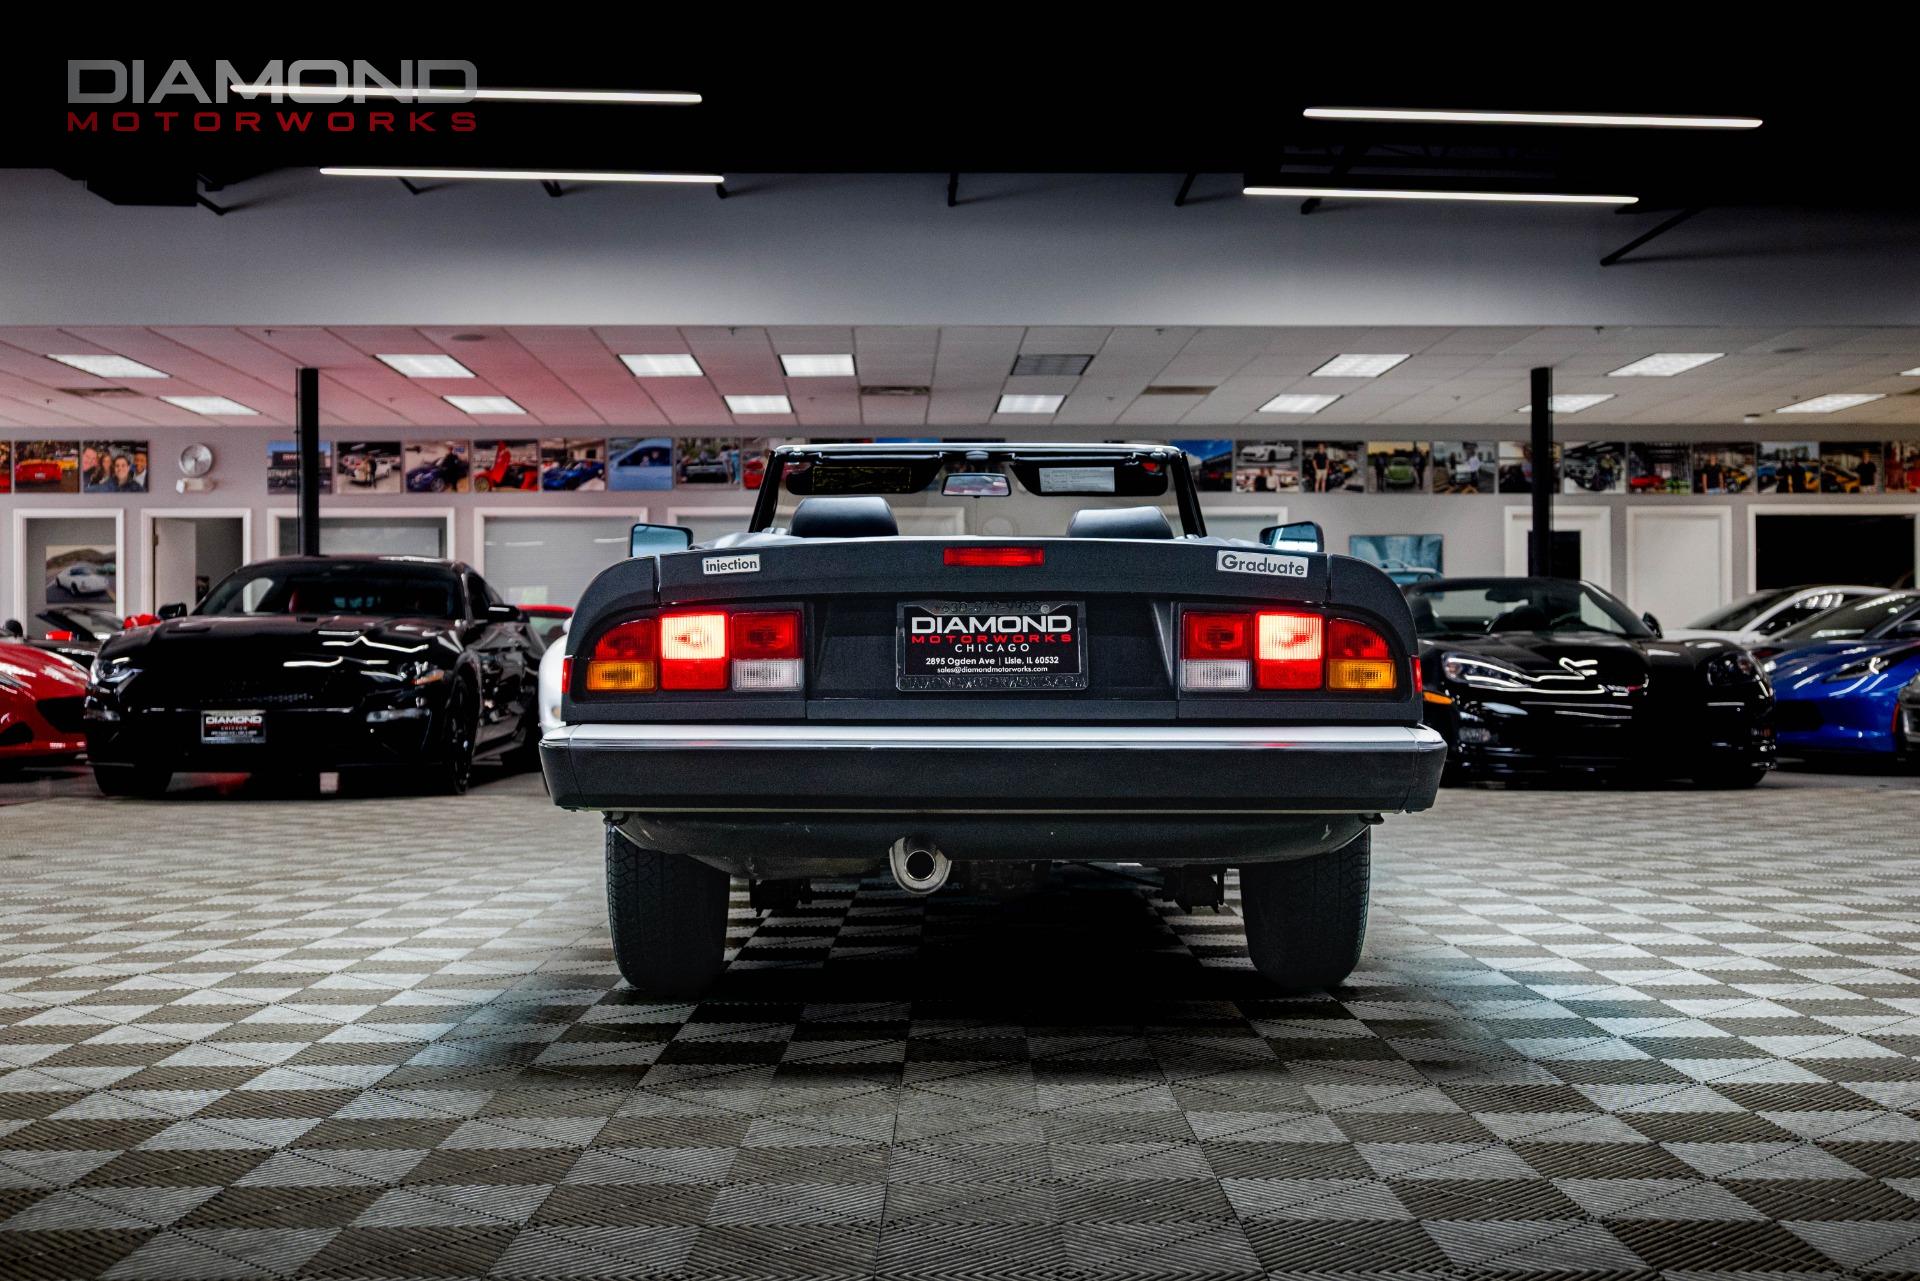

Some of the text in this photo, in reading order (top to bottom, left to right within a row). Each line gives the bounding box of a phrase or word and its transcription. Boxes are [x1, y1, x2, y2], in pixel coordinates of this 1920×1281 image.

[705, 558, 758, 573] injection
[1221, 554, 1305, 576] Graduate
[911, 615, 1072, 634] DIAMOND
[911, 634, 1072, 644] MOTORWORKS
[954, 643, 1030, 653] CHICAGO
[925, 656, 1059, 667] 2895 Ogden Ave Lisle, IL 60532
[937, 665, 1048, 674] sales@diamondmotorworks.com
[206, 716, 263, 724] DIAMOND
